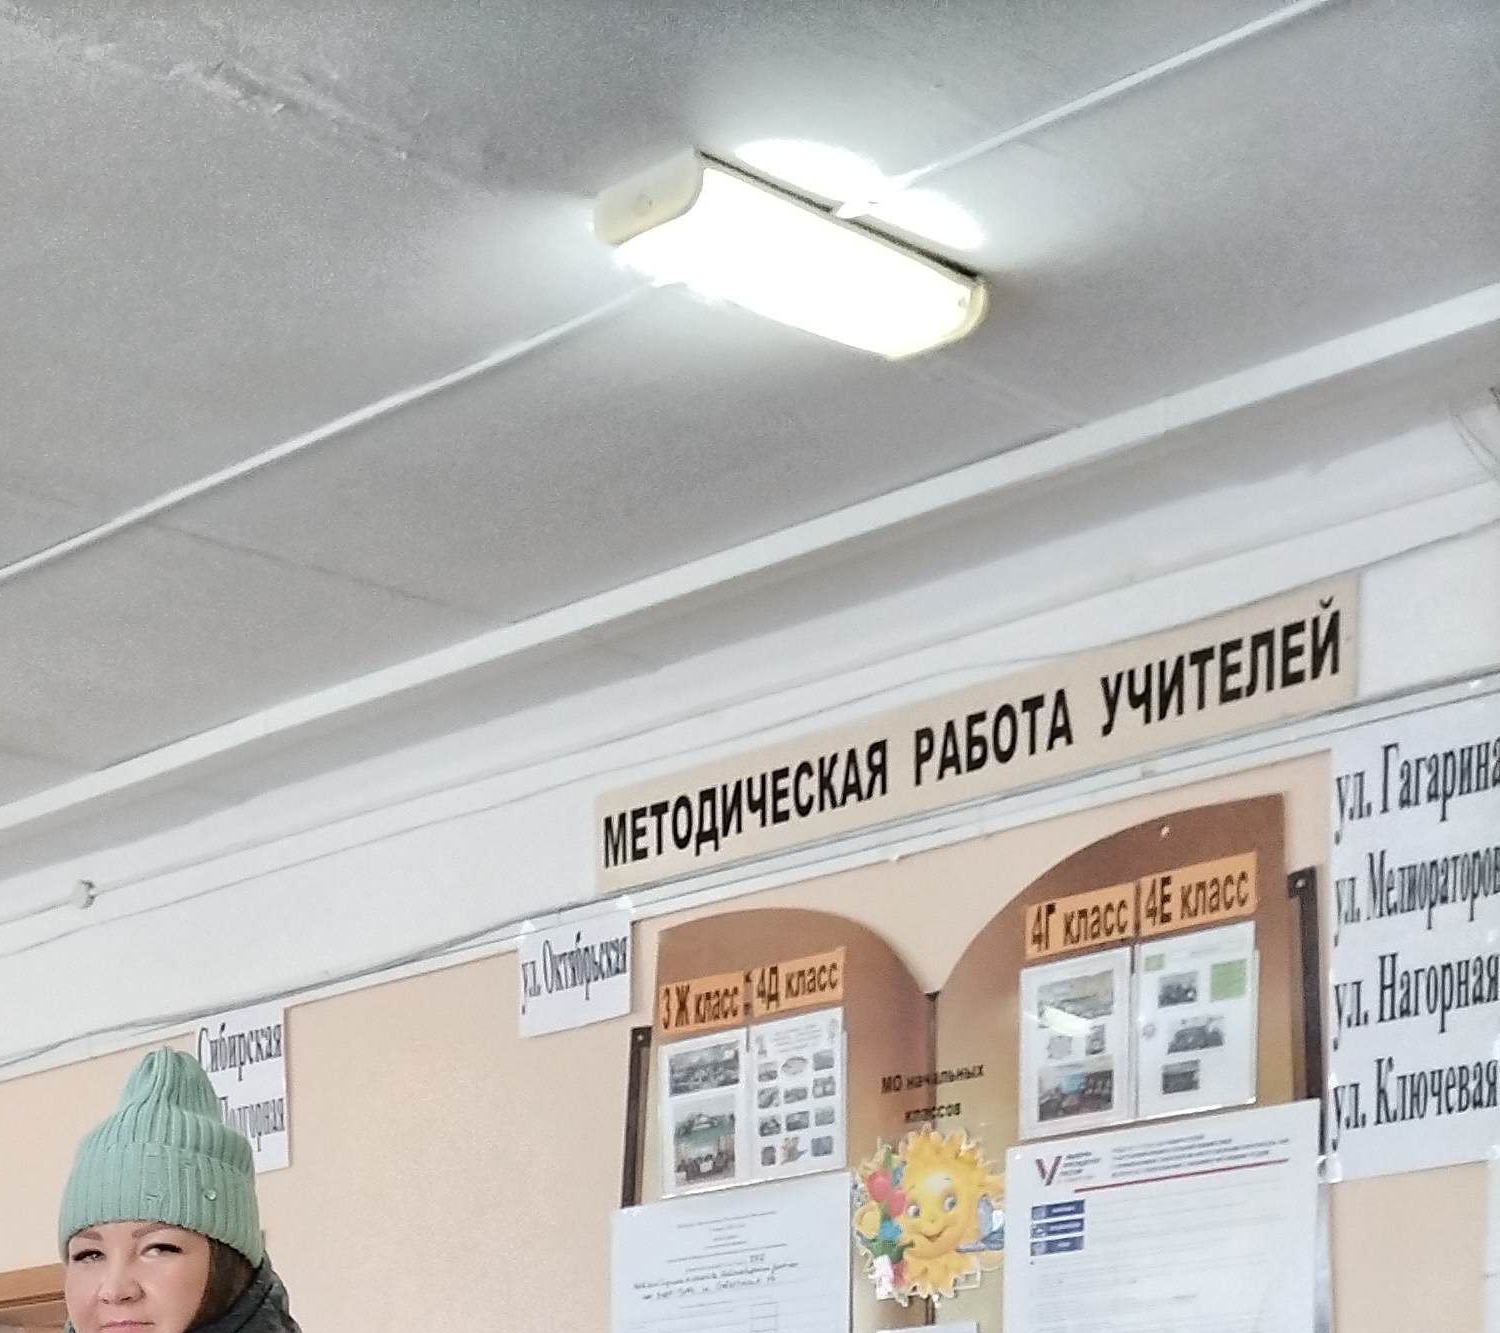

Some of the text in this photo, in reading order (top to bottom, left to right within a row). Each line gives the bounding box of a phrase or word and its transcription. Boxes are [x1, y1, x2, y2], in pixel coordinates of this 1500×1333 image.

[604, 597, 1341, 868] МЕТОДИЧЕСКАЯ РАБОТА УЧИТЕЛЕЙ
[1334, 737, 1500, 846] ул. Гагарина
[1031, 899, 1128, 952] 4Г класс
[1145, 870, 1249, 927] 4Е класс
[1333, 877, 1361, 947] ул.
[520, 931, 627, 1015] ул. Октябрьская
[694, 986, 739, 1024] класс
[756, 961, 839, 1012] 4Д класс
[1333, 952, 1499, 1052] ул. Нагорная
[197, 1022, 282, 1081] Сибирская
[1332, 1056, 1498, 1151] ул. Ключевая
